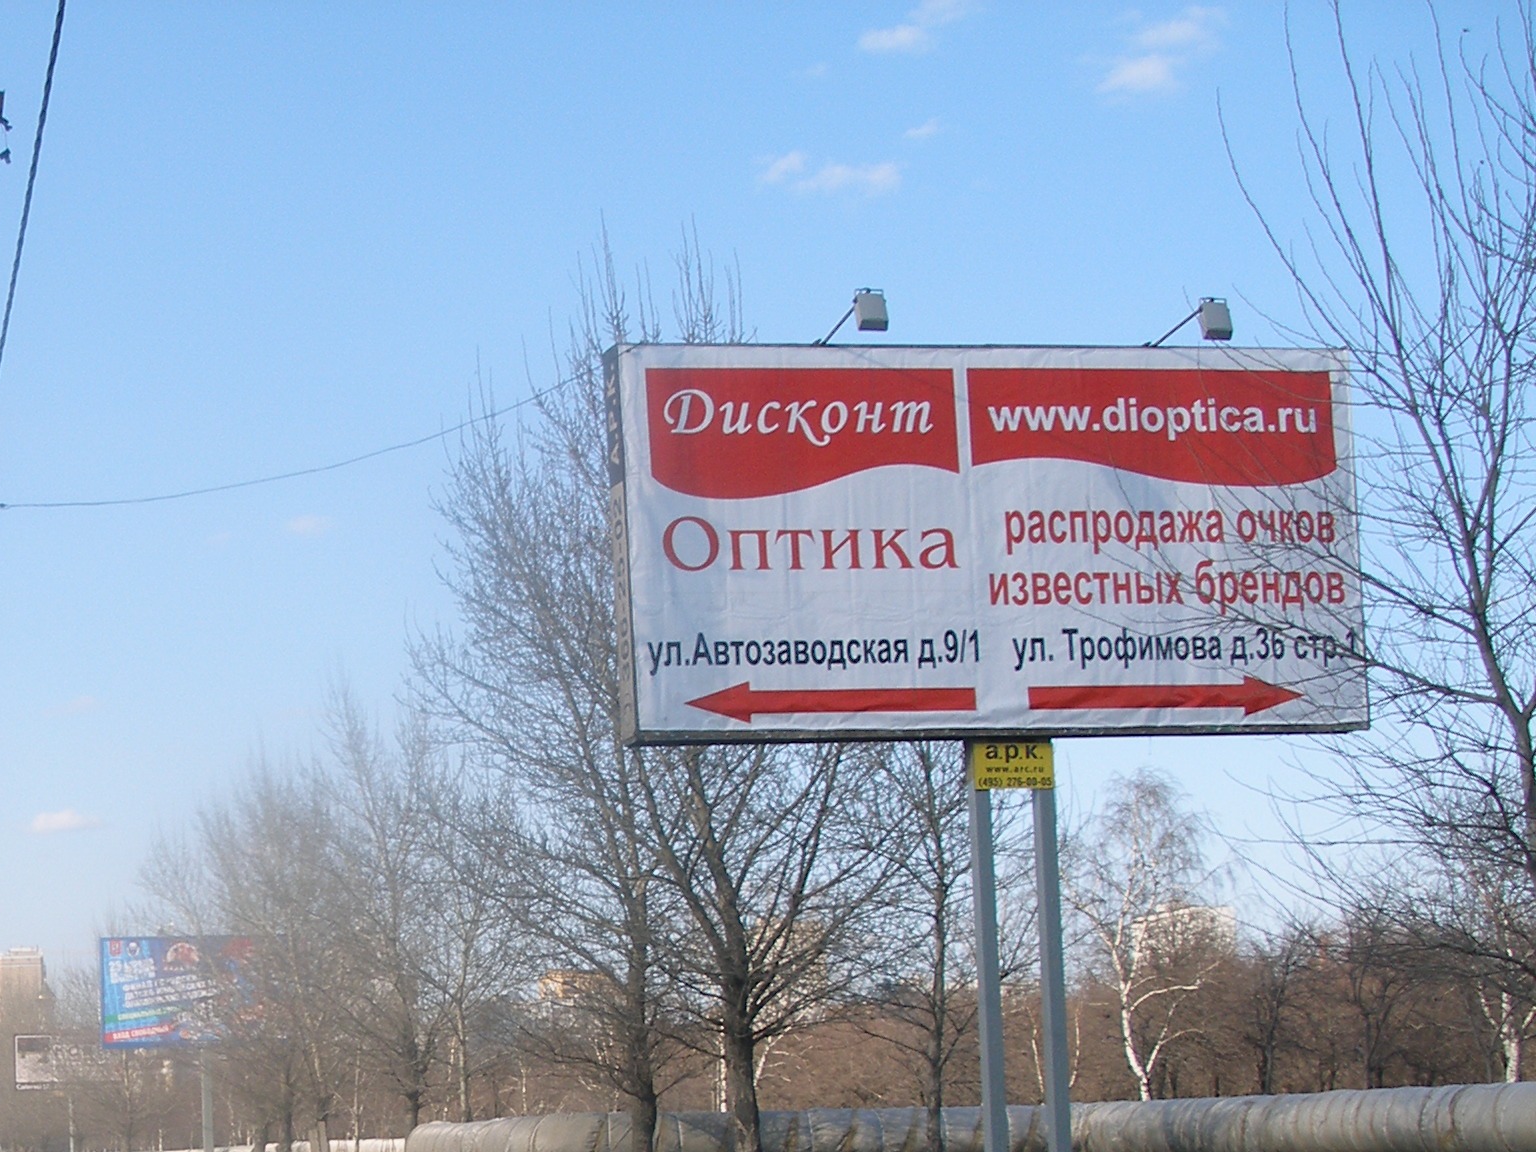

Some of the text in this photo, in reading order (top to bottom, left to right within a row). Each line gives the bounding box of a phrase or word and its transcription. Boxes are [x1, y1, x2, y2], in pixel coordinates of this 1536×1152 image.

[663, 388, 934, 447] Дисконт
[987, 398, 1318, 441] www.dioptica.ru
[662, 516, 961, 572] Оптика
[1005, 509, 1337, 555] распродажа очков
[989, 559, 1346, 615] известных брендов
[647, 629, 980, 676] ул.Автозаводская д.9/1
[1012, 636, 1055, 671] ул.
[1062, 627, 1222, 670] Трофимова
[1229, 627, 1285, 667] д.36
